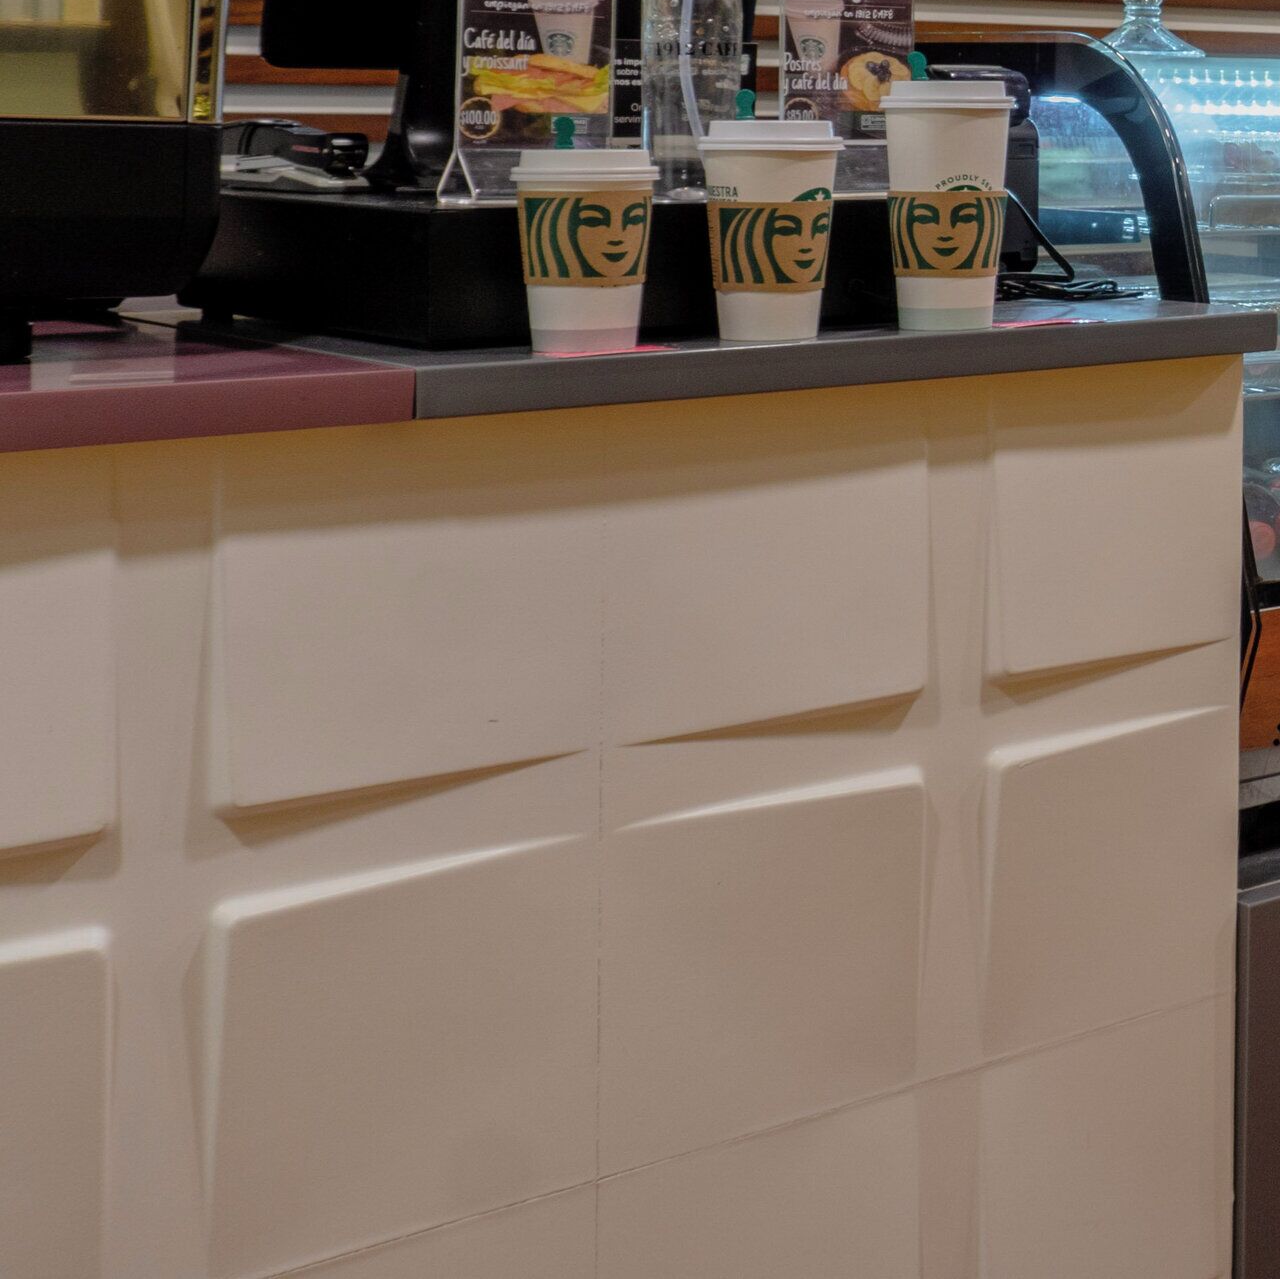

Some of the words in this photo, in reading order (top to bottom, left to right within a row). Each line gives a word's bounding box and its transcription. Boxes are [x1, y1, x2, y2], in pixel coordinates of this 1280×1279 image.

[463, 27, 496, 49] Café
[496, 29, 515, 50] del
[516, 30, 537, 51] día
[461, 55, 471, 77] y
[474, 55, 529, 71] croissant
[784, 51, 822, 72] Postres
[791, 72, 814, 90] café
[815, 72, 831, 90] del
[832, 72, 848, 90] día
[460, 109, 497, 125] $100.00
[934, 174, 979, 190] PROUDLY
